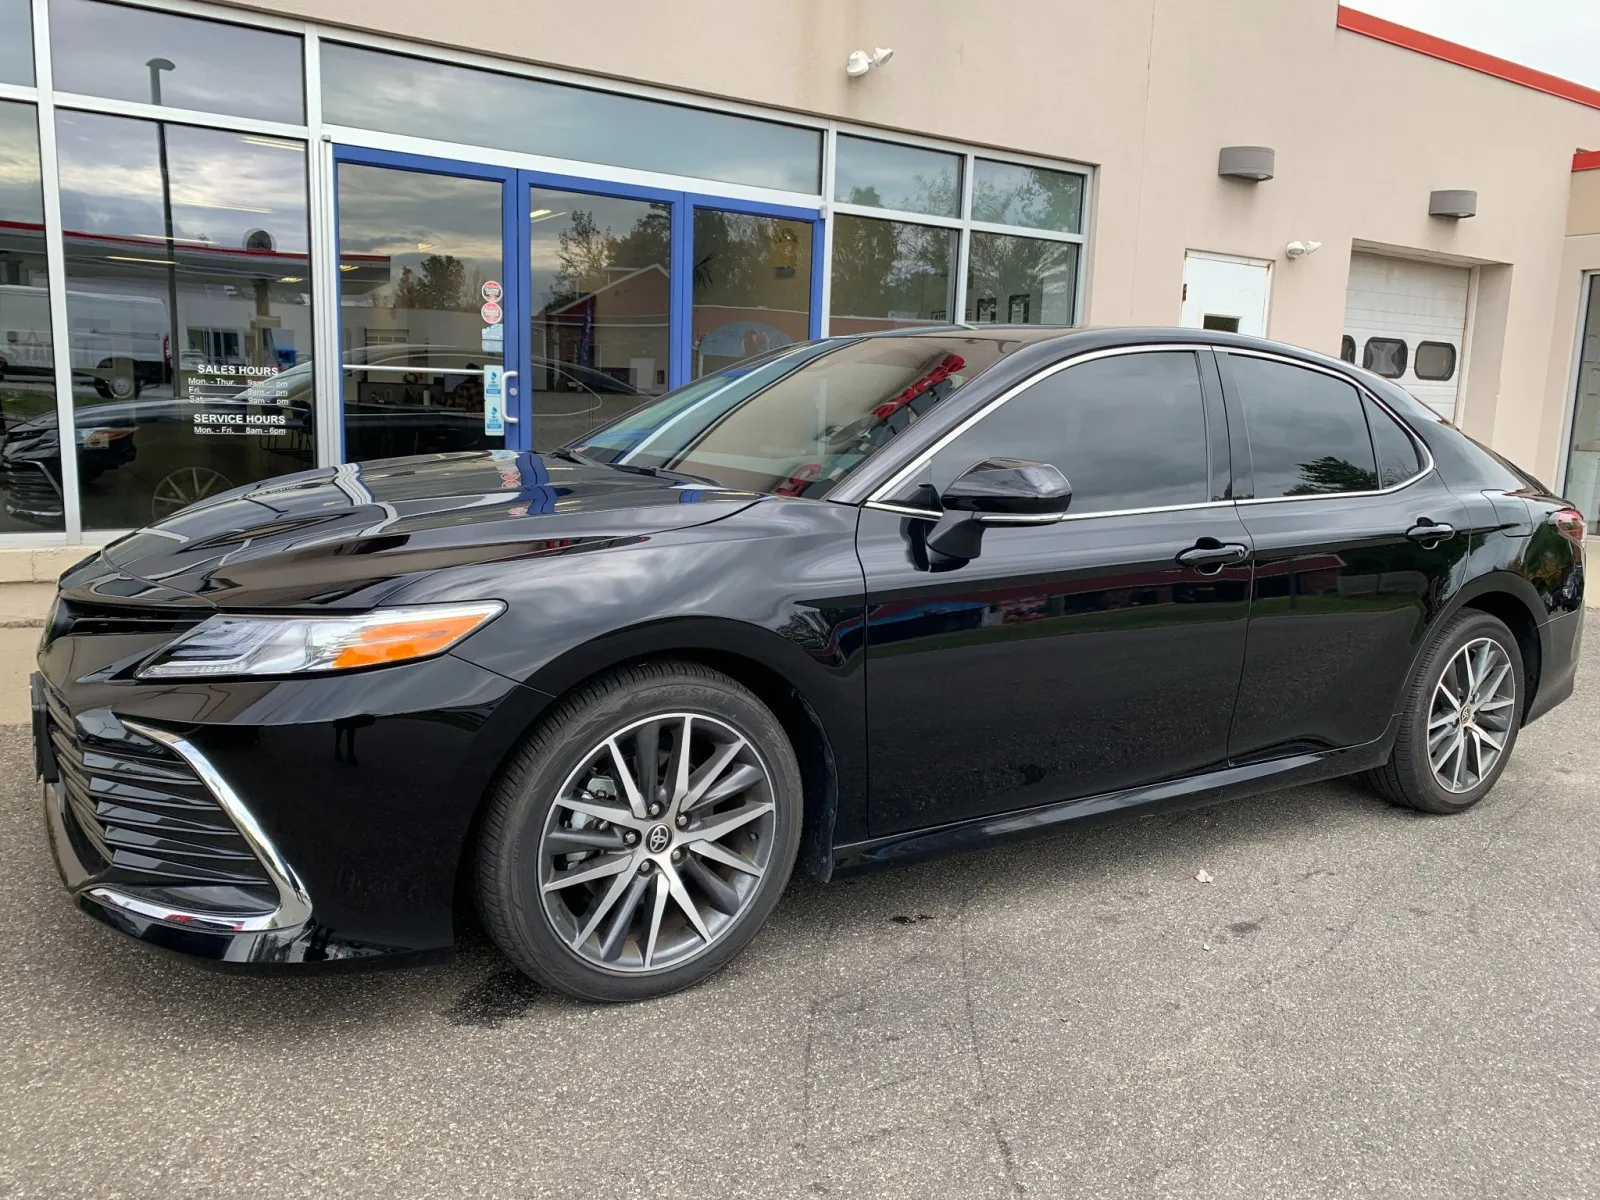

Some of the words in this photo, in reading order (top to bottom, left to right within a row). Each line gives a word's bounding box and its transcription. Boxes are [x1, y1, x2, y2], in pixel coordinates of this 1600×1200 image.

[197, 364, 236, 374] SALES
[239, 366, 279, 376] HOURS
[188, 377, 208, 386] Mon.
[216, 378, 236, 387] Thur.
[247, 379, 264, 387] 9am
[188, 386, 201, 394] Fri.
[247, 388, 264, 396] 9am
[248, 396, 265, 404] 9am
[193, 414, 243, 424] SERVICE
[246, 415, 286, 424] HOURS
[194, 426, 214, 434] Mon.
[221, 426, 234, 434] Fri.
[245, 426, 263, 434] 8am
[269, 427, 286, 436] 6pm
